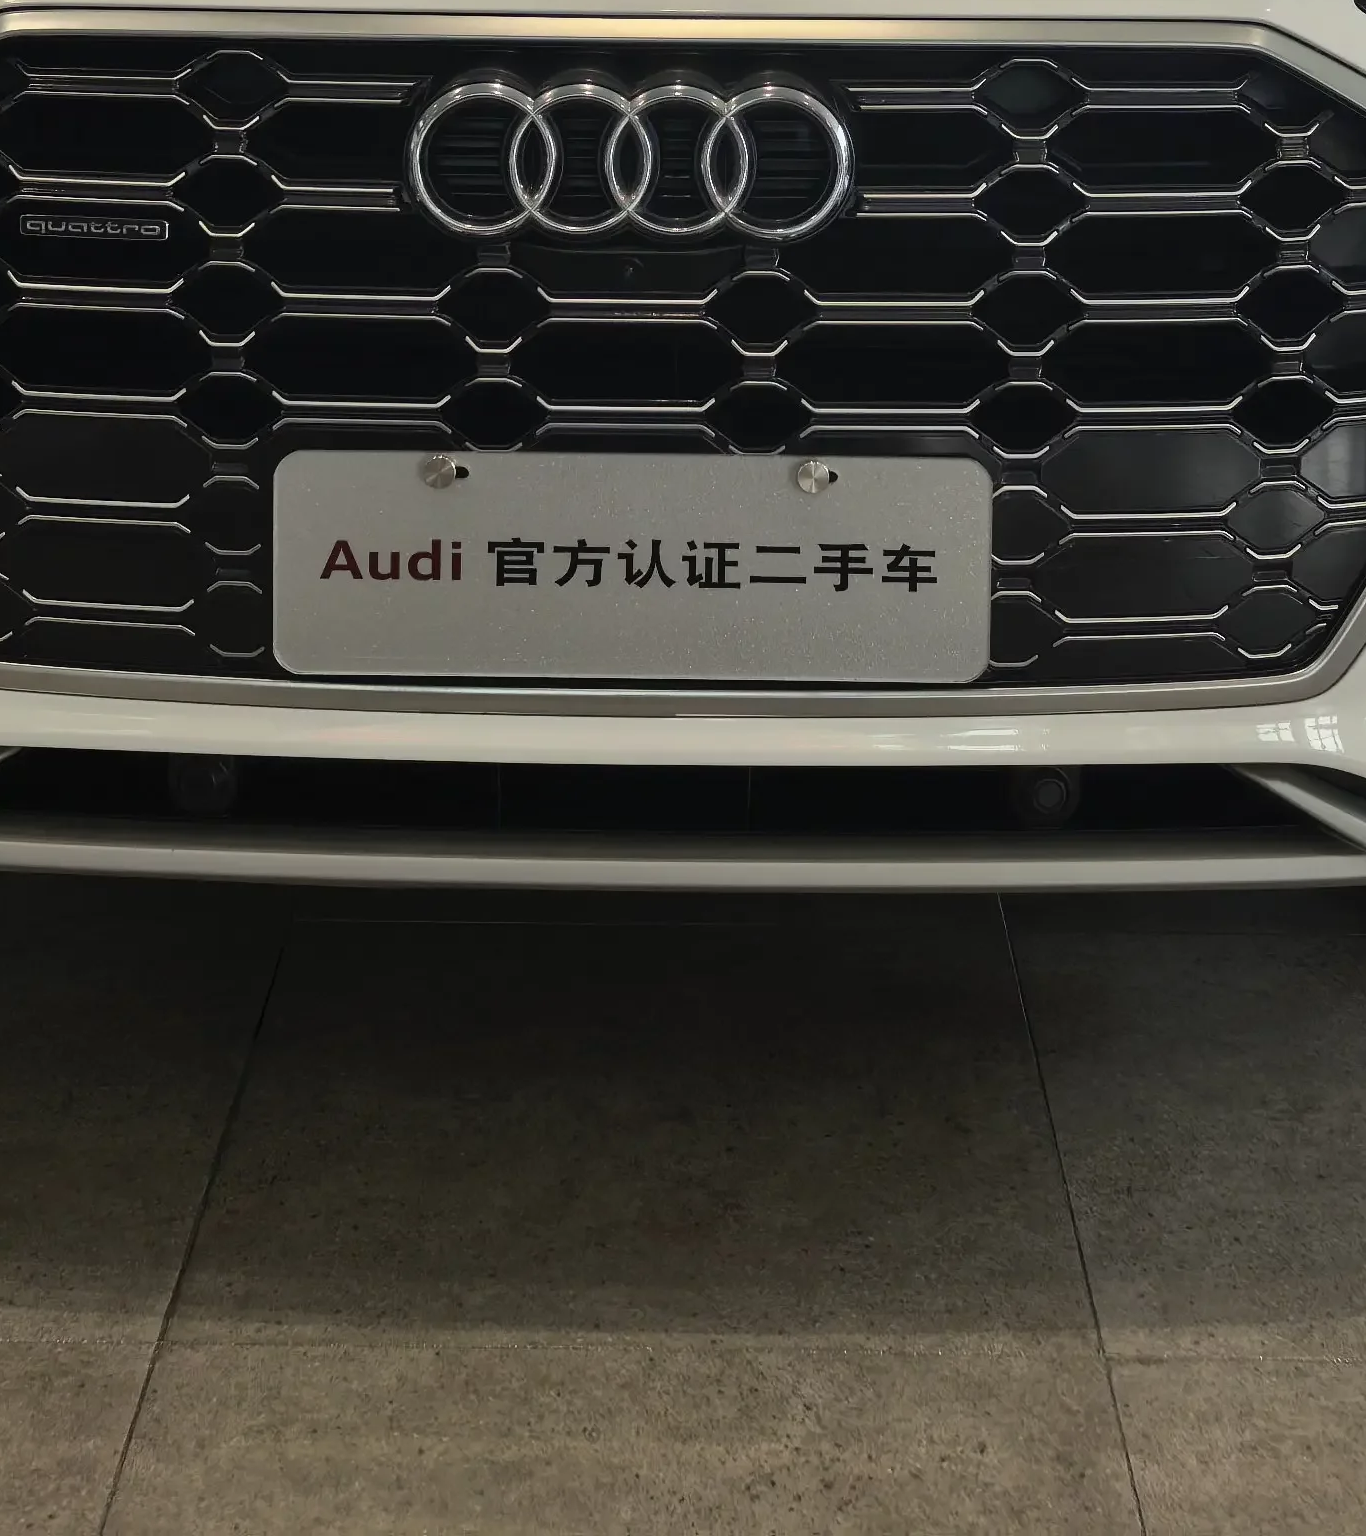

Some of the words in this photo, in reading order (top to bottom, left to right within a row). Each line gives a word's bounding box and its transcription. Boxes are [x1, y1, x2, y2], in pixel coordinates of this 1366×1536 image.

[26, 220, 161, 236] quattro
[319, 539, 462, 581] Audi
[487, 537, 938, 593] 官方认证二手车
